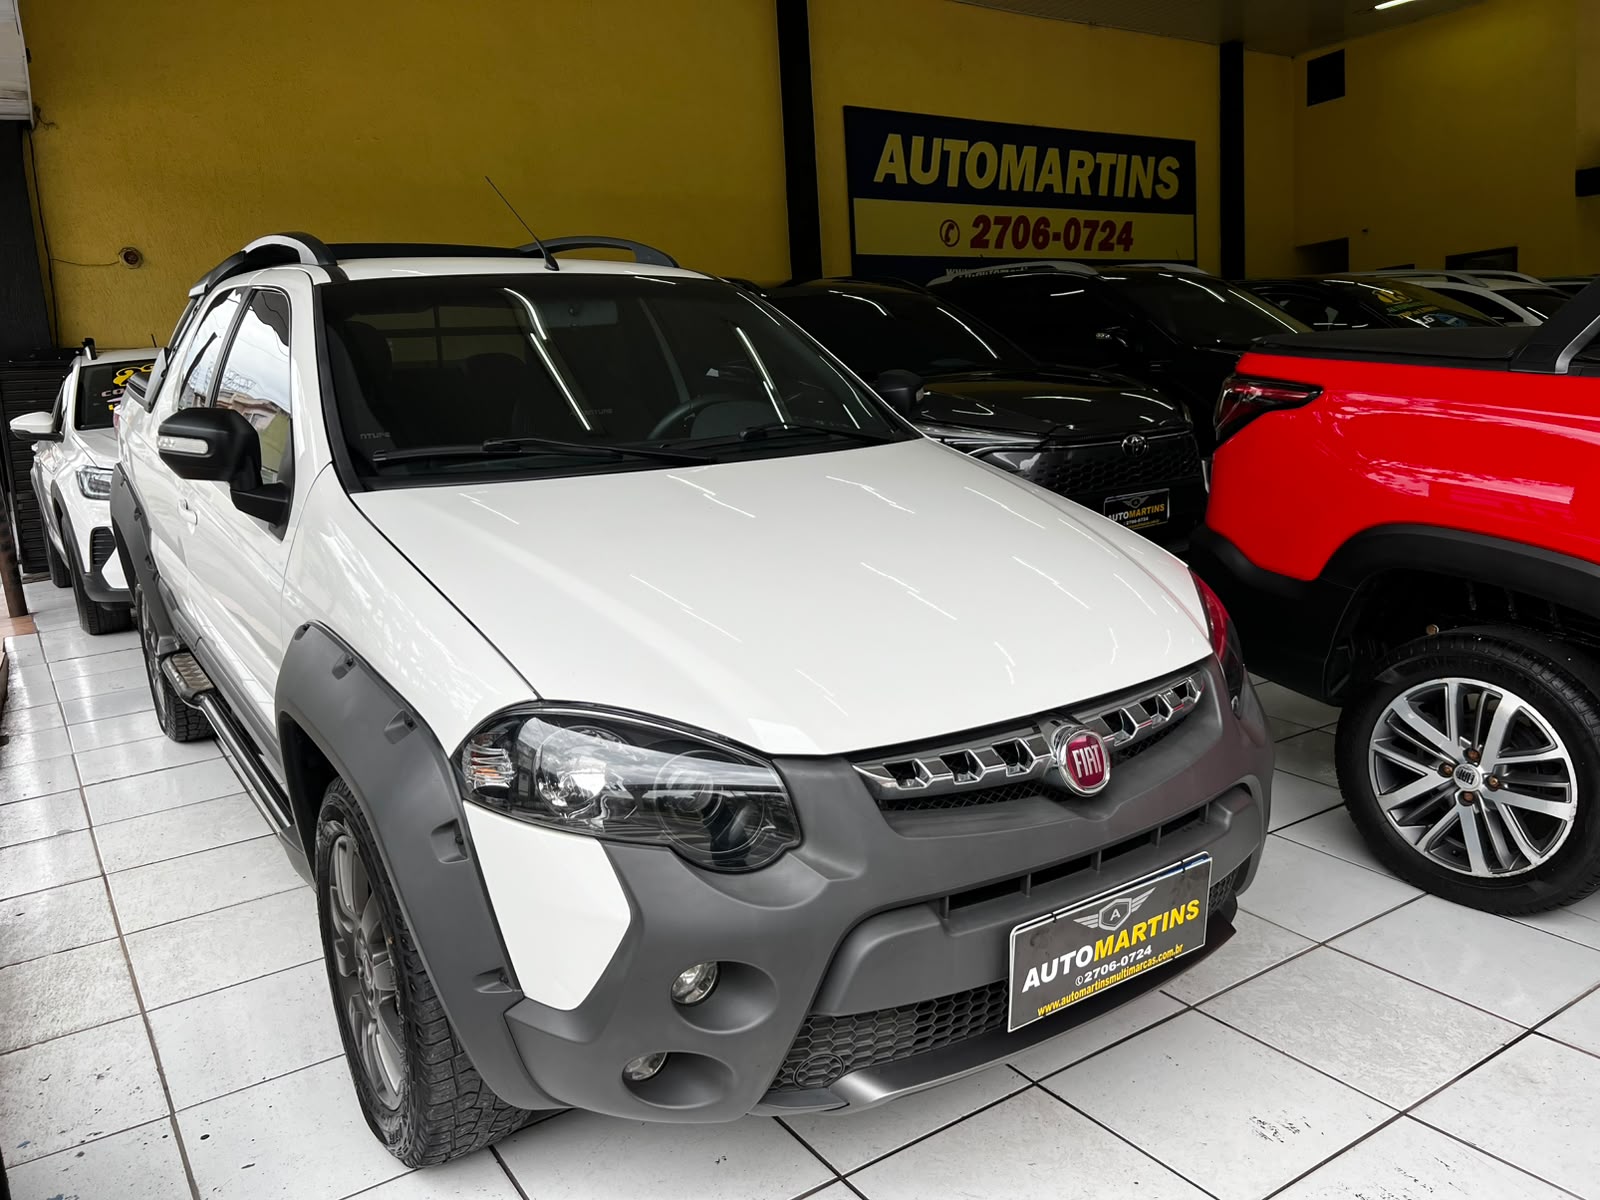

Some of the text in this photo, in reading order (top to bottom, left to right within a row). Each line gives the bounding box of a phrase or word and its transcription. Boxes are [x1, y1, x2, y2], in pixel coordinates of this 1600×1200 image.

[873, 133, 1180, 200] AUTOMARTINS
[970, 214, 1134, 252] 2706-0724
[1072, 744, 1102, 778] FIAT
[1021, 899, 1200, 993] AUTOMARTINS
[1083, 945, 1152, 983] 2706-0724
[1037, 943, 1183, 1017] www.automartinsmultimarcas.com.br
